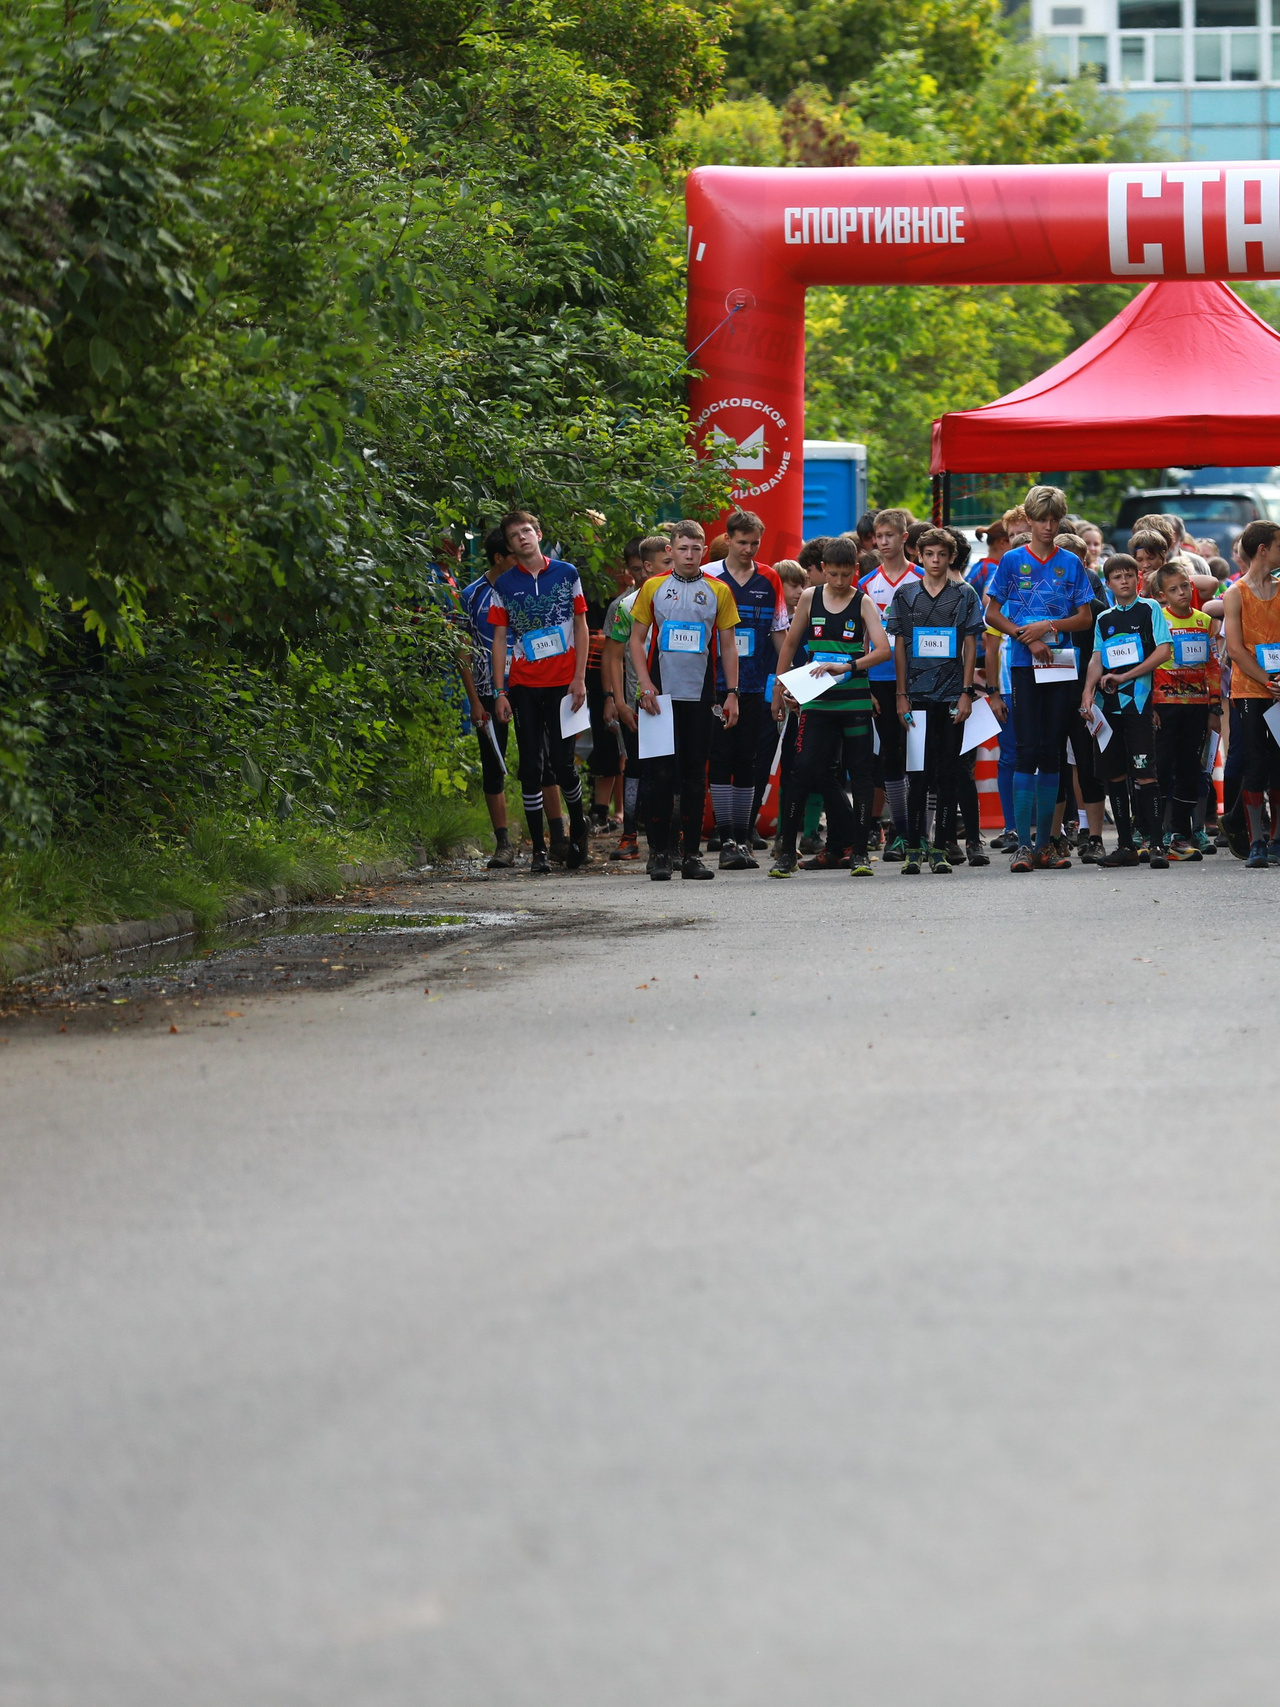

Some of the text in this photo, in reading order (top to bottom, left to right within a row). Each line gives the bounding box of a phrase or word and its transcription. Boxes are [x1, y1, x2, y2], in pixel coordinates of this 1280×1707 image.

[784, 206, 965, 244] СПОРТИВНОЕ
[695, 398, 787, 429] МОСКОВСКОЕ
[536, 640, 554, 650] 330.1
[1112, 647, 1131, 656] 306.1
